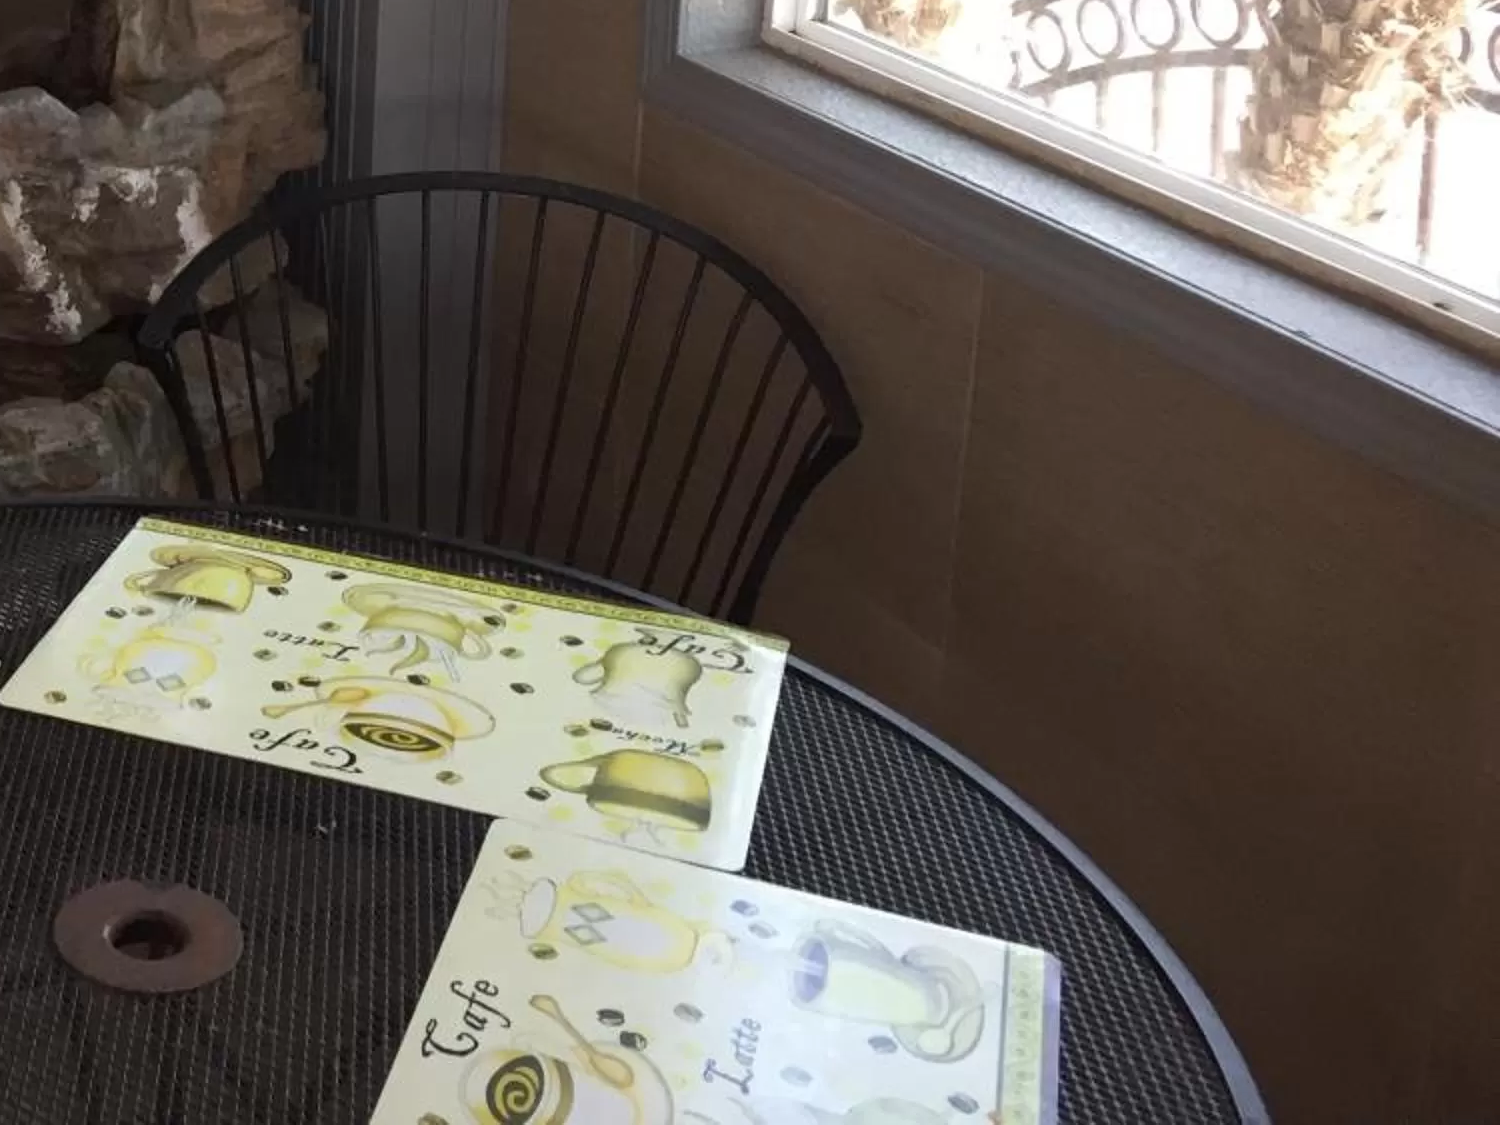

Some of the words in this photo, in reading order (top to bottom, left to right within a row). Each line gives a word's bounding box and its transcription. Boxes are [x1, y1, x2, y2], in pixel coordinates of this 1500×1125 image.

[264, 628, 361, 662] Latte
[635, 628, 754, 673] Cafe
[250, 728, 364, 774] Cafe
[421, 978, 512, 1059] Cafe
[703, 1016, 763, 1096] Latte
